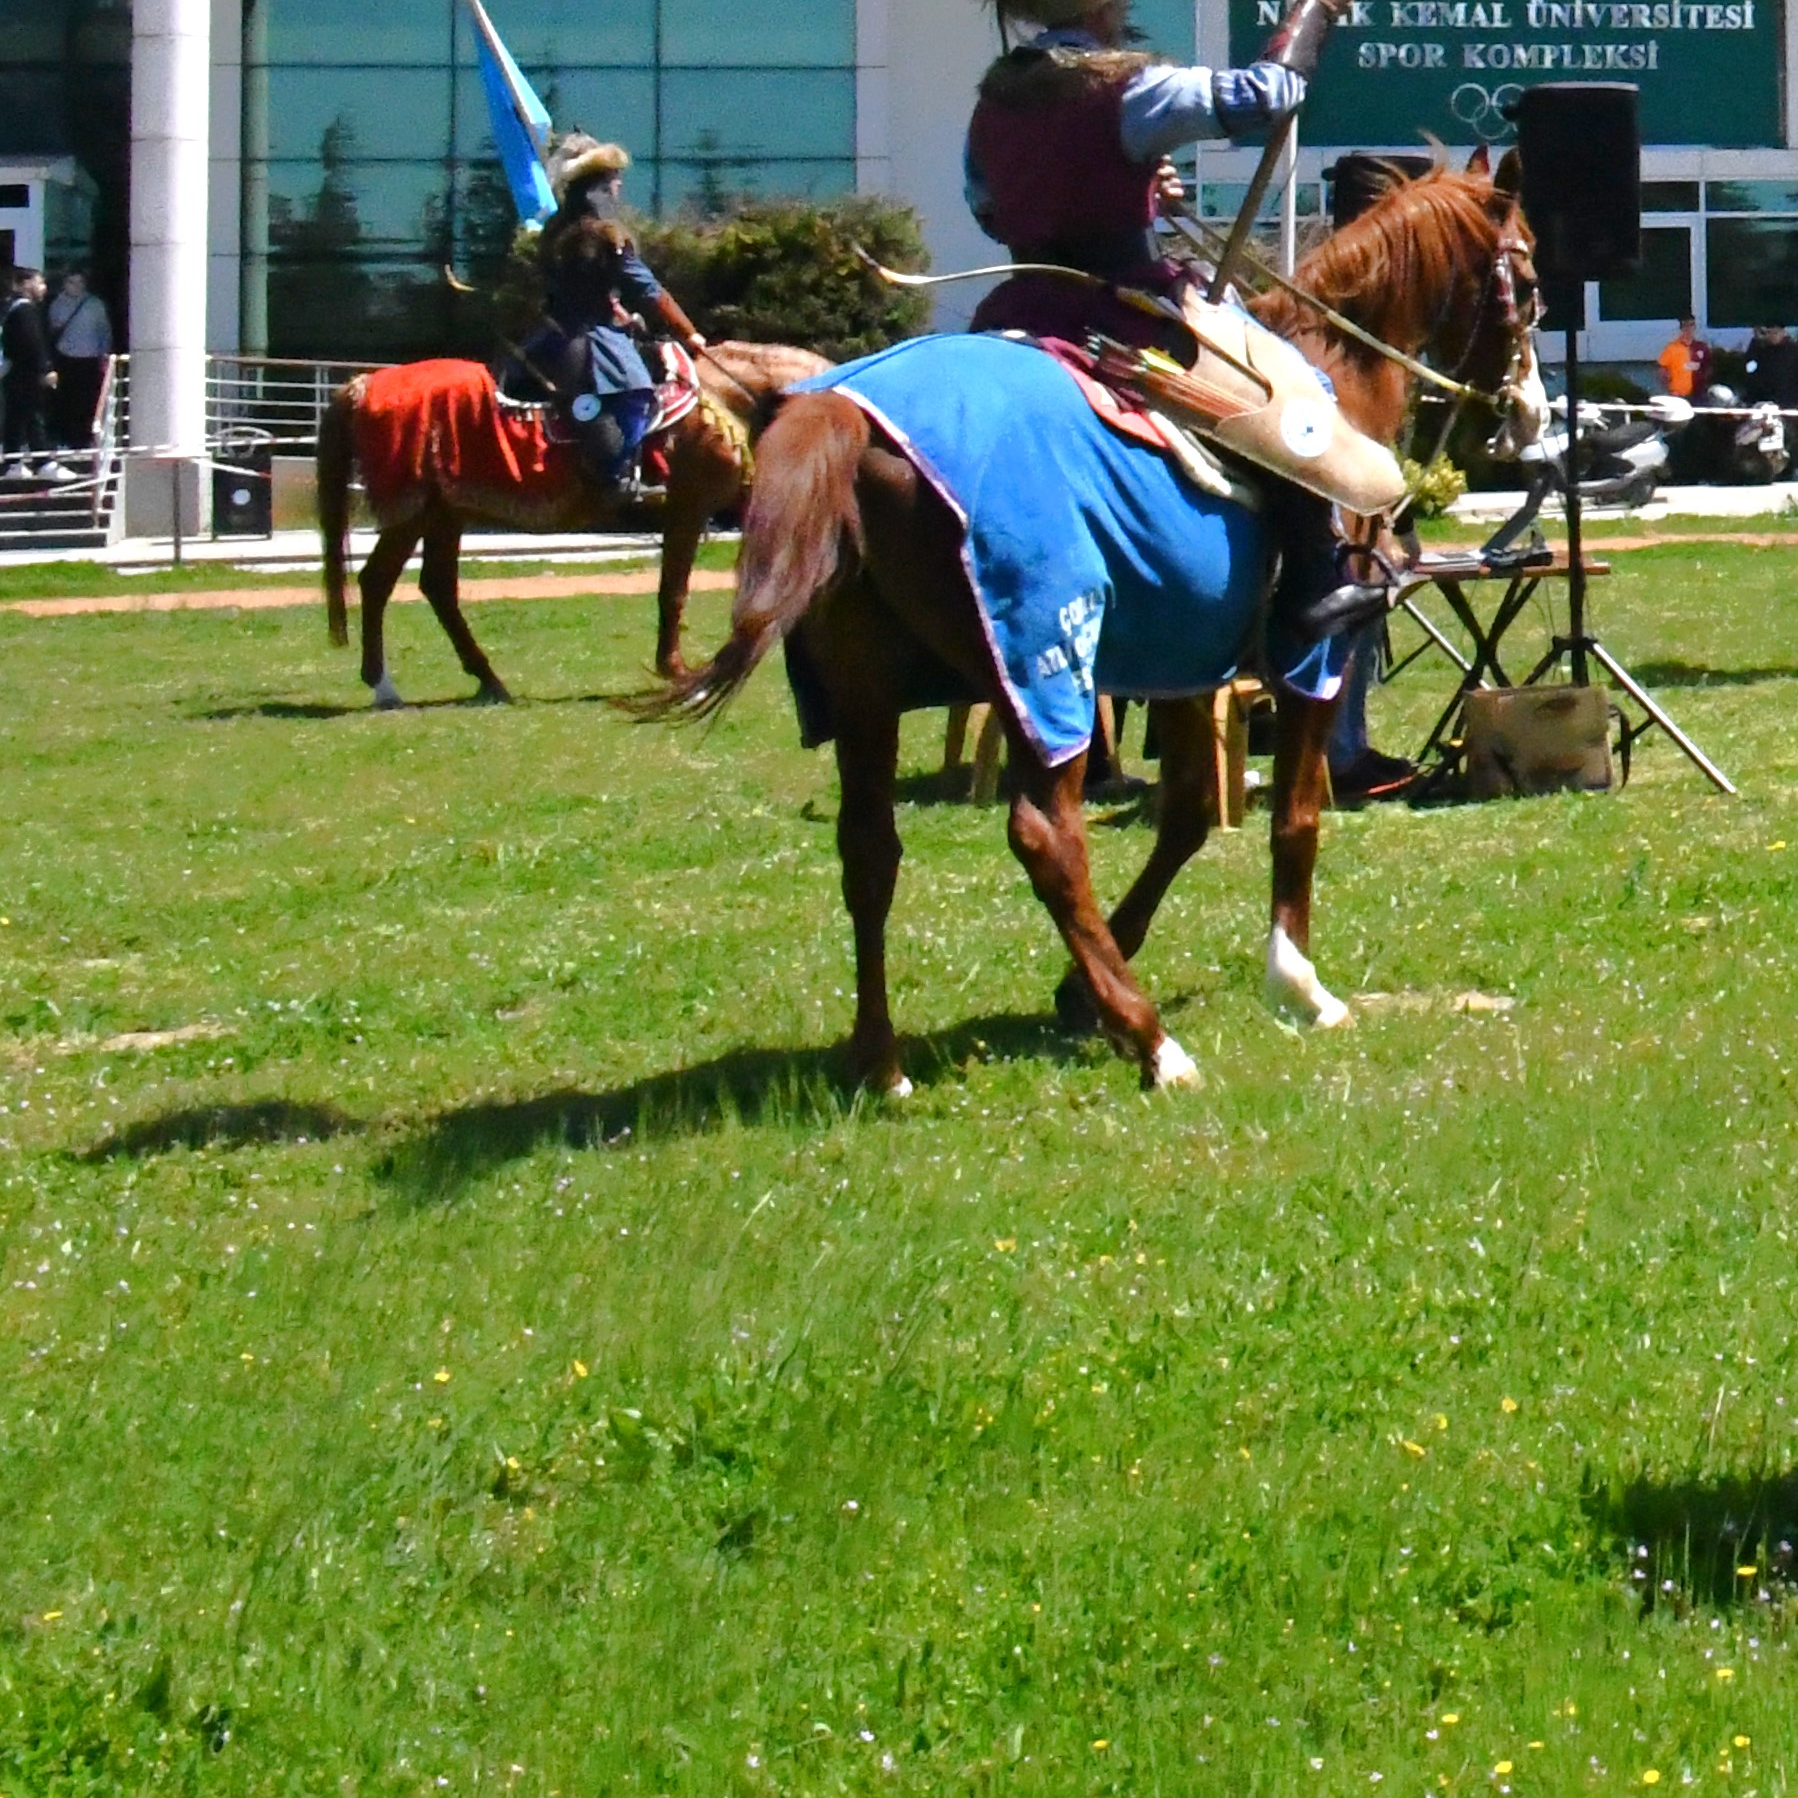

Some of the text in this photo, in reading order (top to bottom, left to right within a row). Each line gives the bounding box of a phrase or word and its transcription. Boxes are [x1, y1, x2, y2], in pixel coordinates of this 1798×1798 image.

[1256, 0, 1376, 27] NIK
[1390, 1, 1512, 28] KEMAL
[1358, 39, 1659, 70] SPOR KOMPLEKSİ
